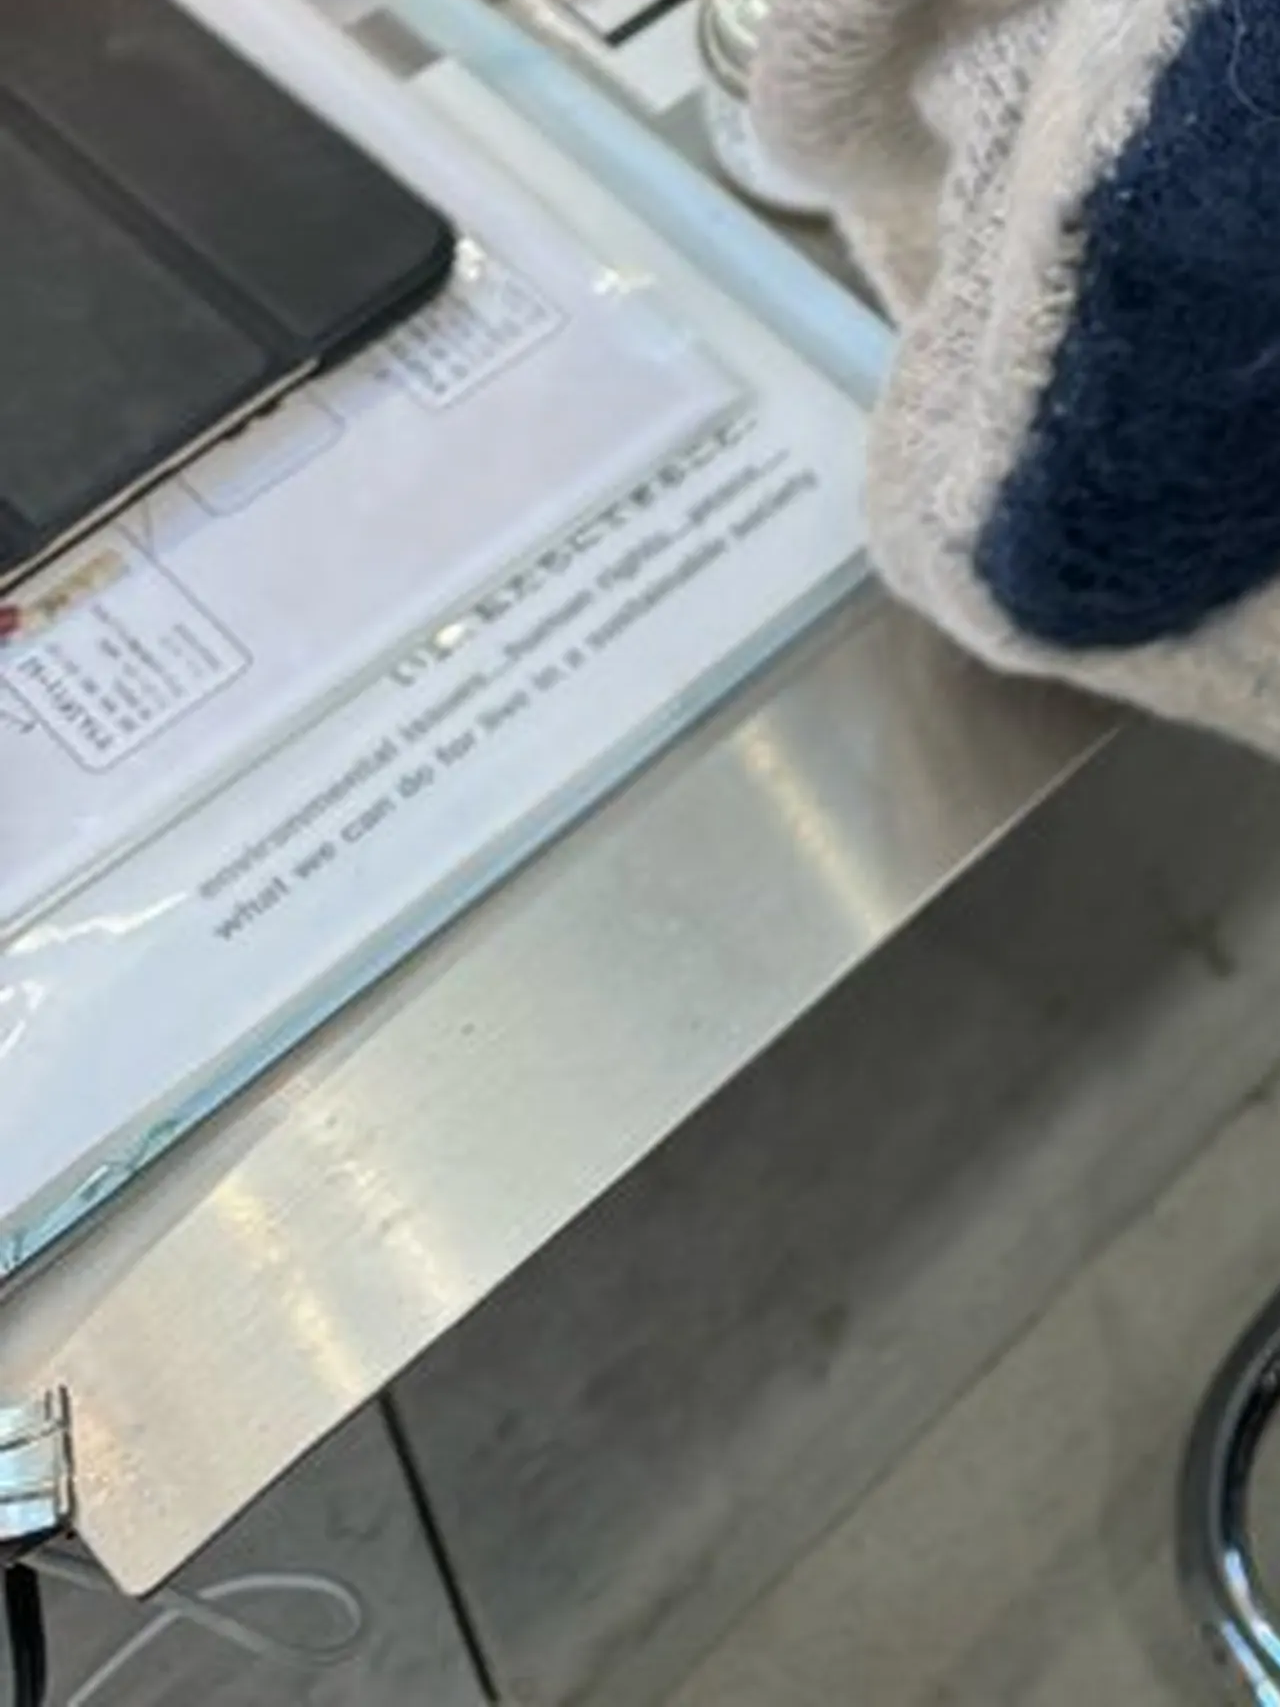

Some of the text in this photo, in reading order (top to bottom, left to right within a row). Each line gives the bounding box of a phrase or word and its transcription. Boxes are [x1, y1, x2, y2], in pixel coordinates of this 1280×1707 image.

[212, 874, 292, 943] what
[292, 841, 337, 880] we
[339, 796, 397, 844] can
[395, 764, 436, 800] do
[433, 728, 478, 769] for
